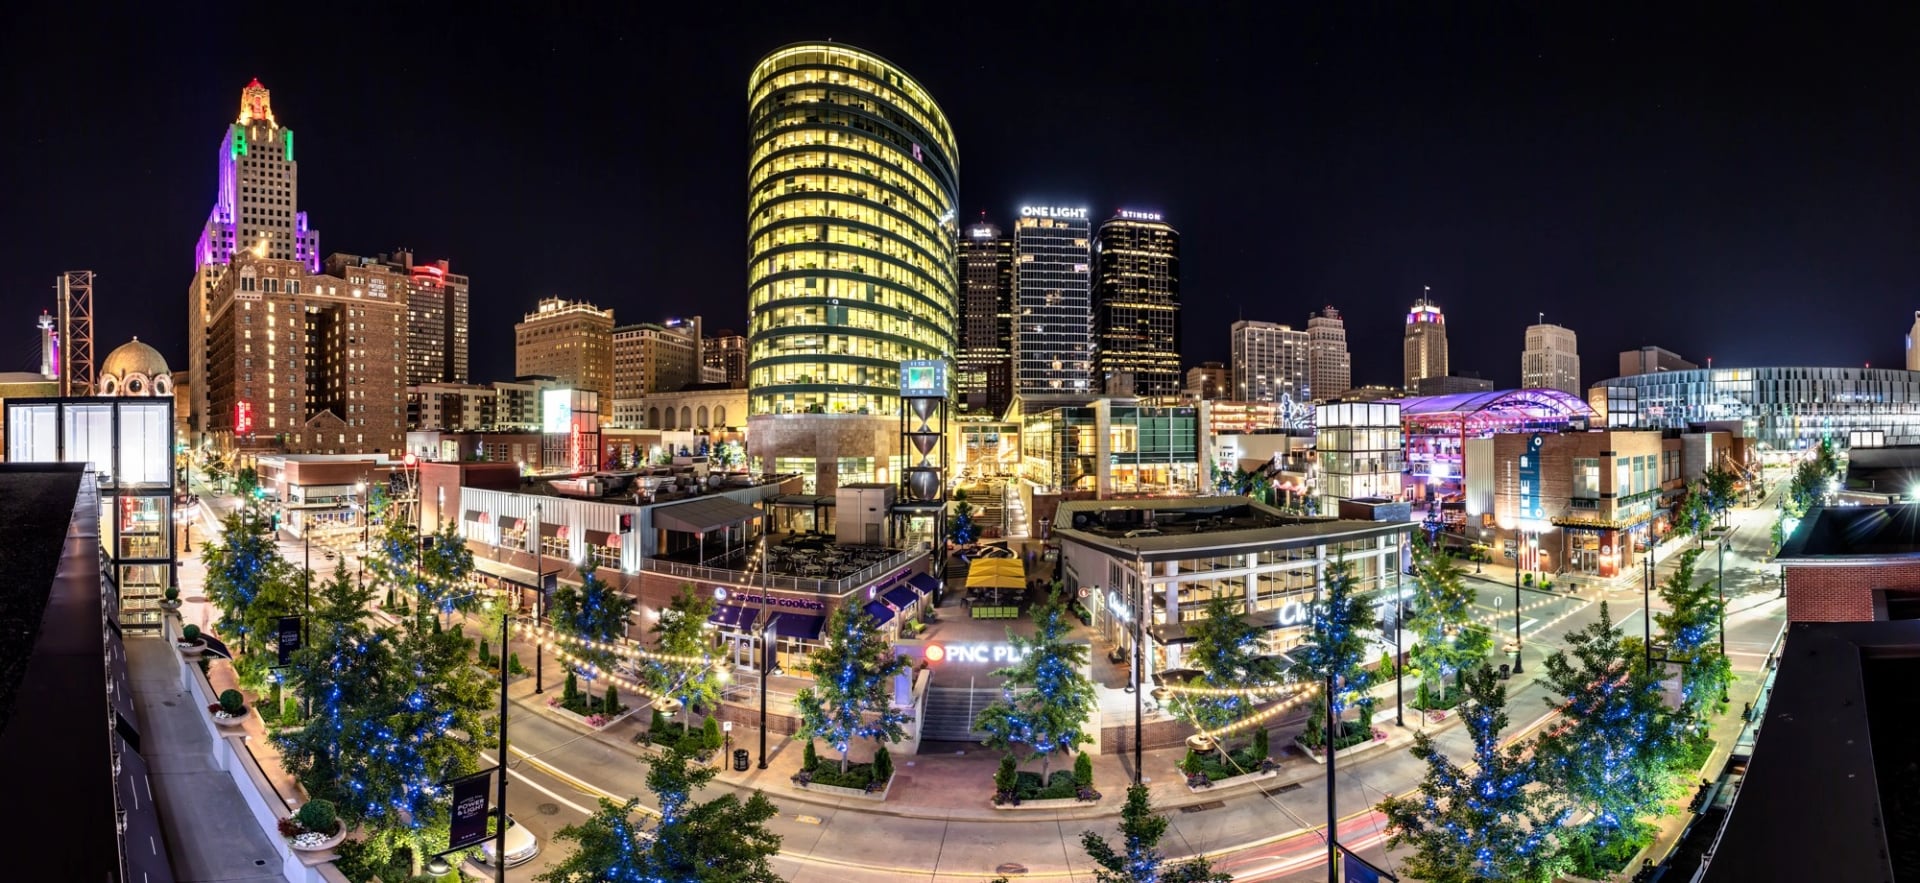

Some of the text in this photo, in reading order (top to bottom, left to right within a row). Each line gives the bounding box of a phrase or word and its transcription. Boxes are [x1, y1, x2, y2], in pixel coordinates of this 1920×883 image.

[1021, 206, 1087, 219] ONE LIGHT
[1122, 211, 1161, 221] STINSON
[779, 598, 824, 611] cookies
[945, 645, 989, 662] PNC
[457, 798, 485, 811] POWER
[463, 803, 484, 815] LIGHT
